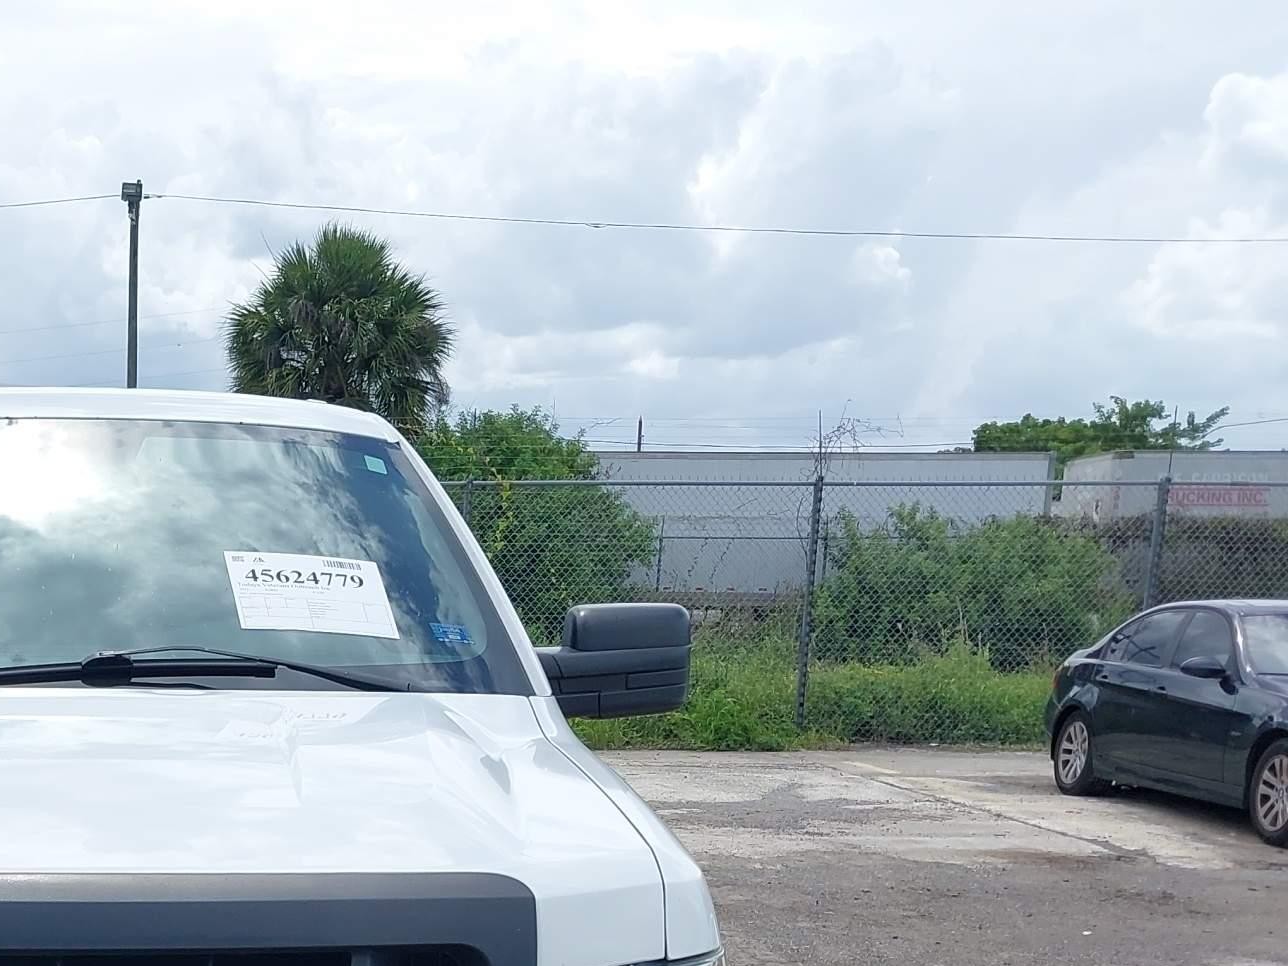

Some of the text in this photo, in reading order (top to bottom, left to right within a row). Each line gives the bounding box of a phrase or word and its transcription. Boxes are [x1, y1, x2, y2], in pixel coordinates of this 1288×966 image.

[1167, 490, 1267, 504] RUCKING INC.
[245, 569, 364, 588] 45624779
